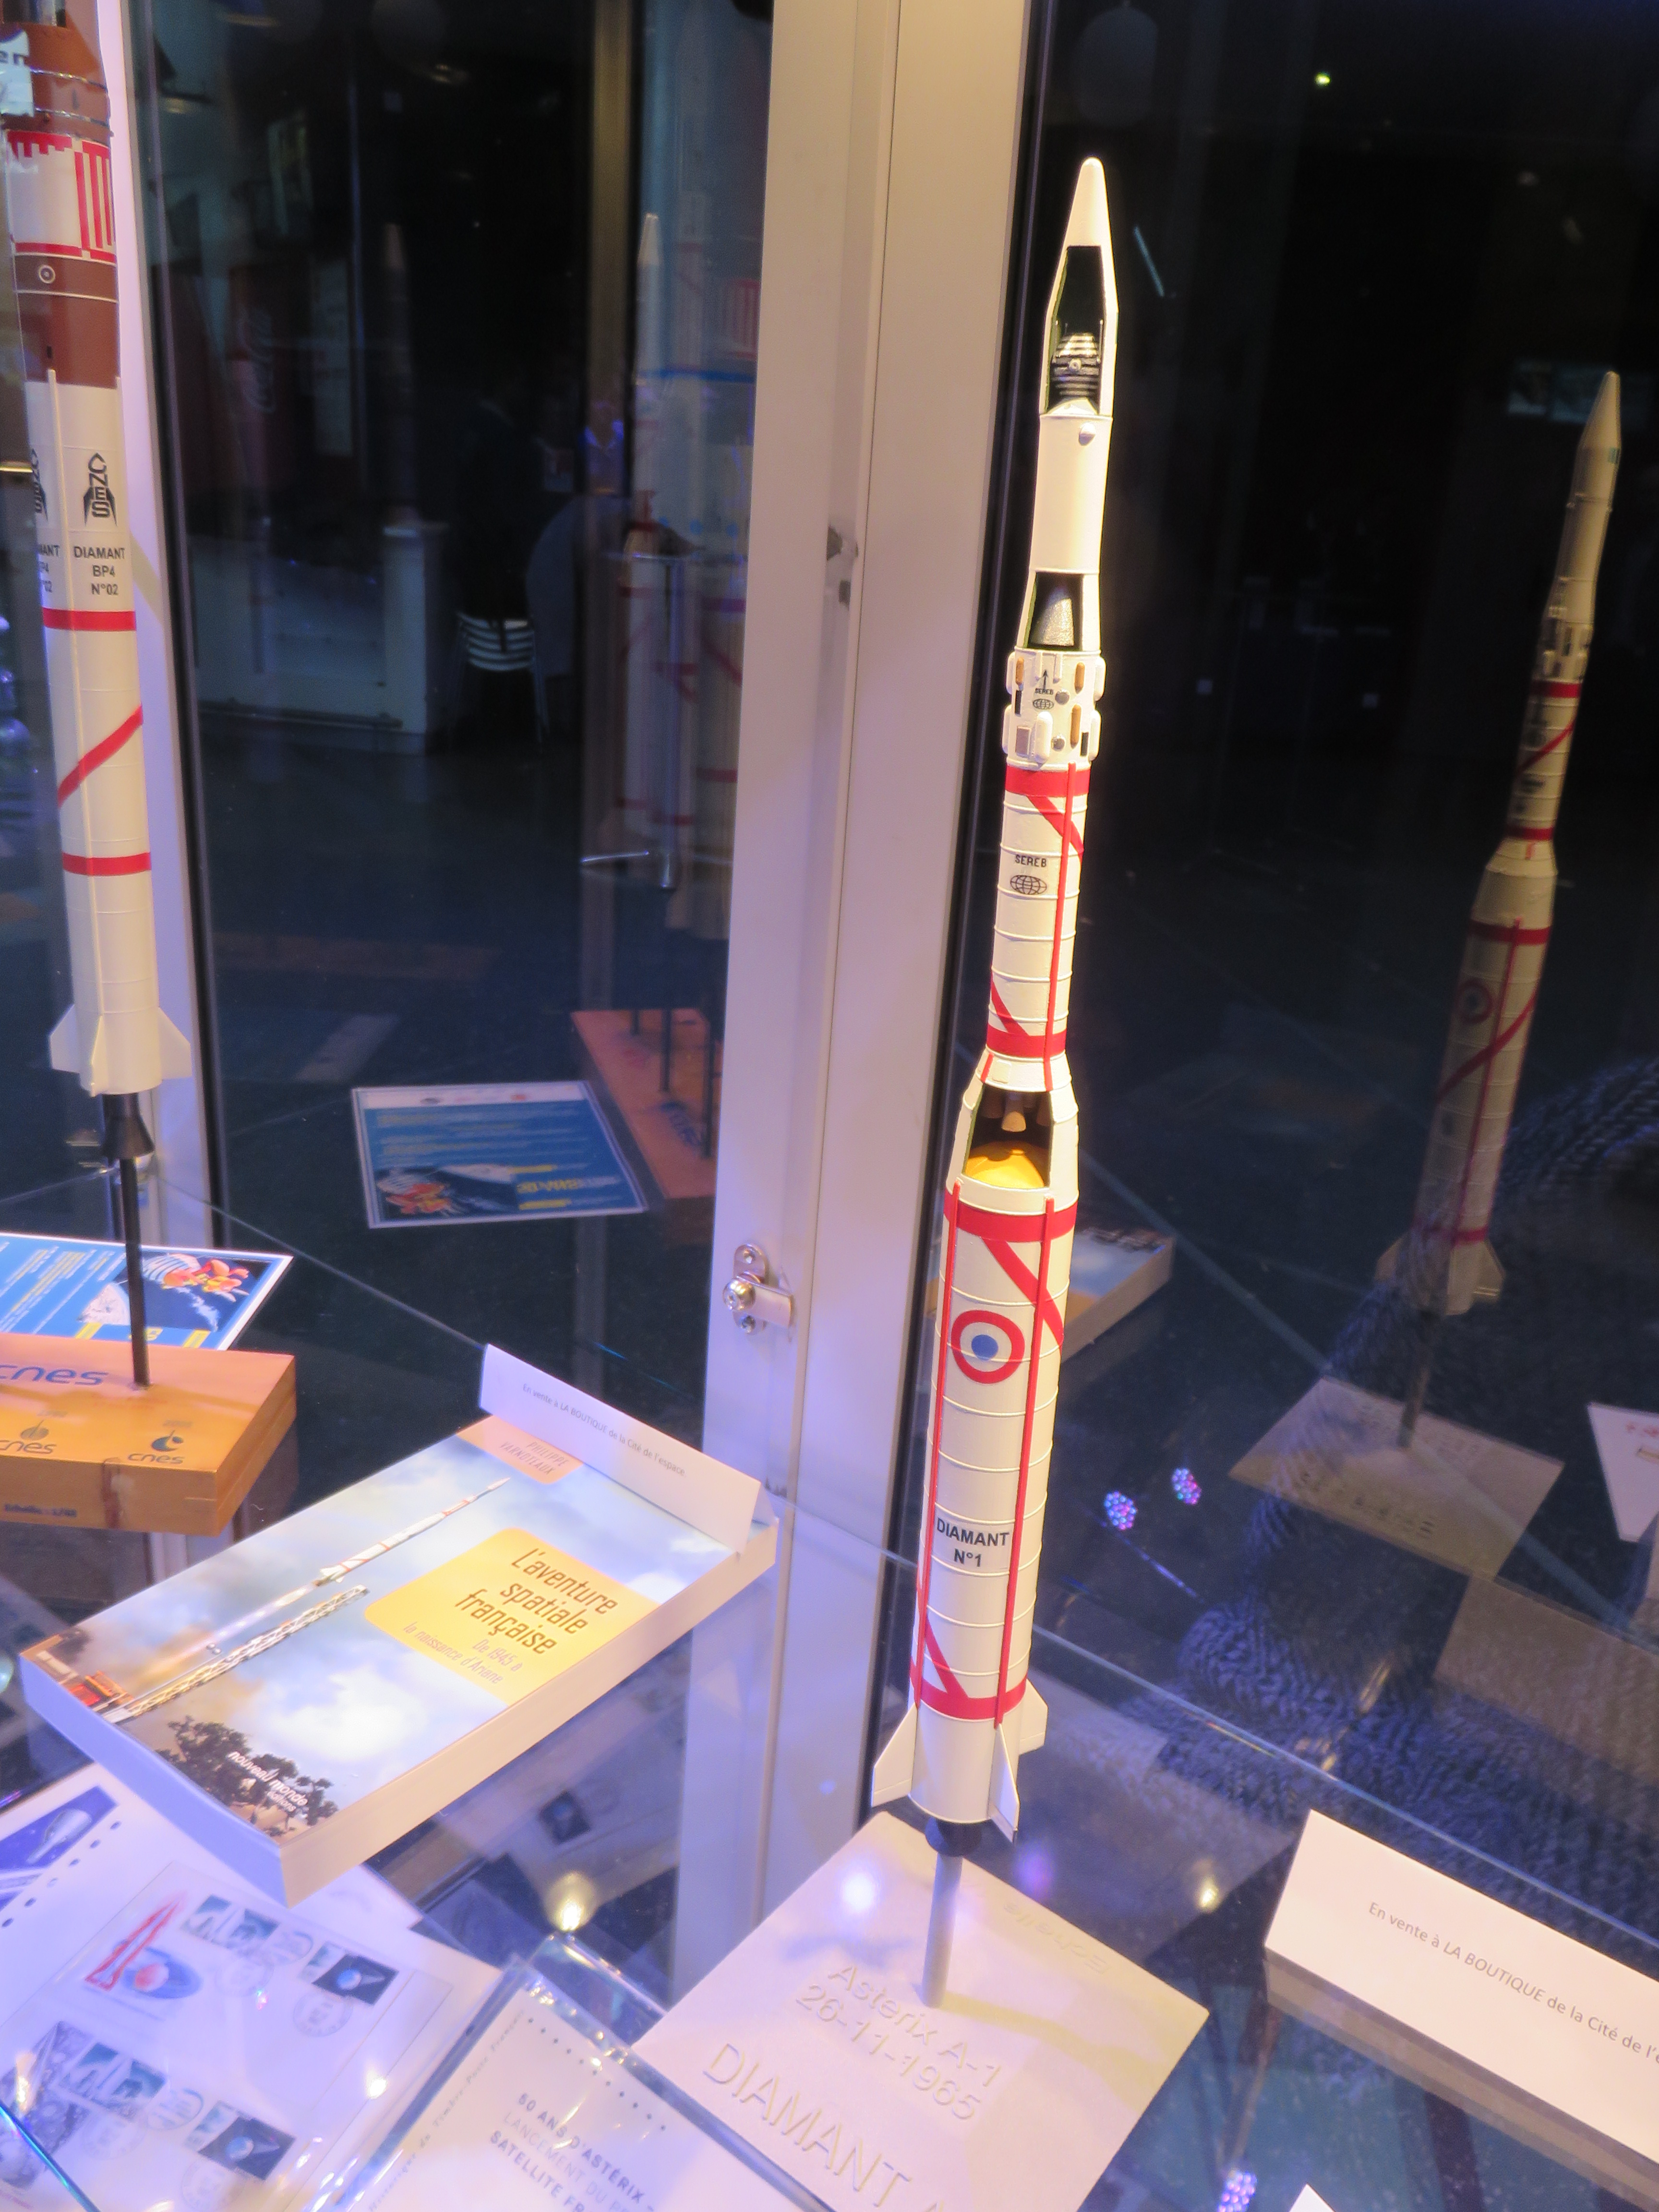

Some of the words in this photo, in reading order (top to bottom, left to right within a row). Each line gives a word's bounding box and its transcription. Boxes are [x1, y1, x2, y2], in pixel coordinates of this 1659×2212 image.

[87, 452, 111, 518] CNES
[73, 546, 125, 559] DIAMANT
[93, 565, 116, 577] BP4
[91, 582, 119, 595] N°02
[1015, 854, 1047, 868] SEREB
[523, 1383, 532, 1394] En
[533, 1390, 553, 1405] vente
[554, 1399, 559, 1407] à
[560, 1402, 569, 1412] LA
[570, 1407, 608, 1433] BOUTIQUE
[609, 1429, 618, 1440] de
[619, 1434, 626, 1444] la
[627, 1439, 642, 1453] Cité
[643, 1448, 653, 1458] de
[128, 1453, 185, 1464] cnes
[499, 1442, 556, 1475] VARNOTEAUX
[526, 1441, 569, 1467] PHILIPPE
[937, 1517, 1010, 1547] DIAMANT
[953, 1548, 983, 1568] N°1
[500, 1582, 589, 1635] spatiale
[511, 1547, 619, 1616] L'aventure
[454, 1587, 557, 1655] française
[403, 1621, 418, 1634] la
[414, 1630, 464, 1661] naissance
[459, 1656, 504, 1684] d'Ariane
[472, 1638, 490, 1653] De
[487, 1647, 518, 1666] 1945
[228, 1751, 280, 1782] nouveau
[269, 1779, 309, 1806] monde
[1368, 1901, 1386, 1920] En
[1389, 1914, 1429, 1942] vente
[1431, 1933, 1440, 1948] à
[1443, 1941, 1462, 1960] LA
[1464, 1952, 1547, 2002] BOUTIQUE
[1547, 1996, 1566, 2014] de
[1570, 2005, 1584, 2023] la
[1587, 2016, 1619, 2041] Cité
[1622, 2035, 1642, 2054] de
[796, 1984, 981, 2120] 26-11-1965
[827, 1966, 938, 2046] Asterix
[938, 2040, 1002, 2088] A-1
[537, 2110, 568, 2138] ANS
[702, 2043, 913, 2208] DIAMANT
[490, 2129, 564, 2199] SATELLITE
[504, 2111, 587, 2183] LANCEMENT
[585, 2180, 608, 2204] DU
